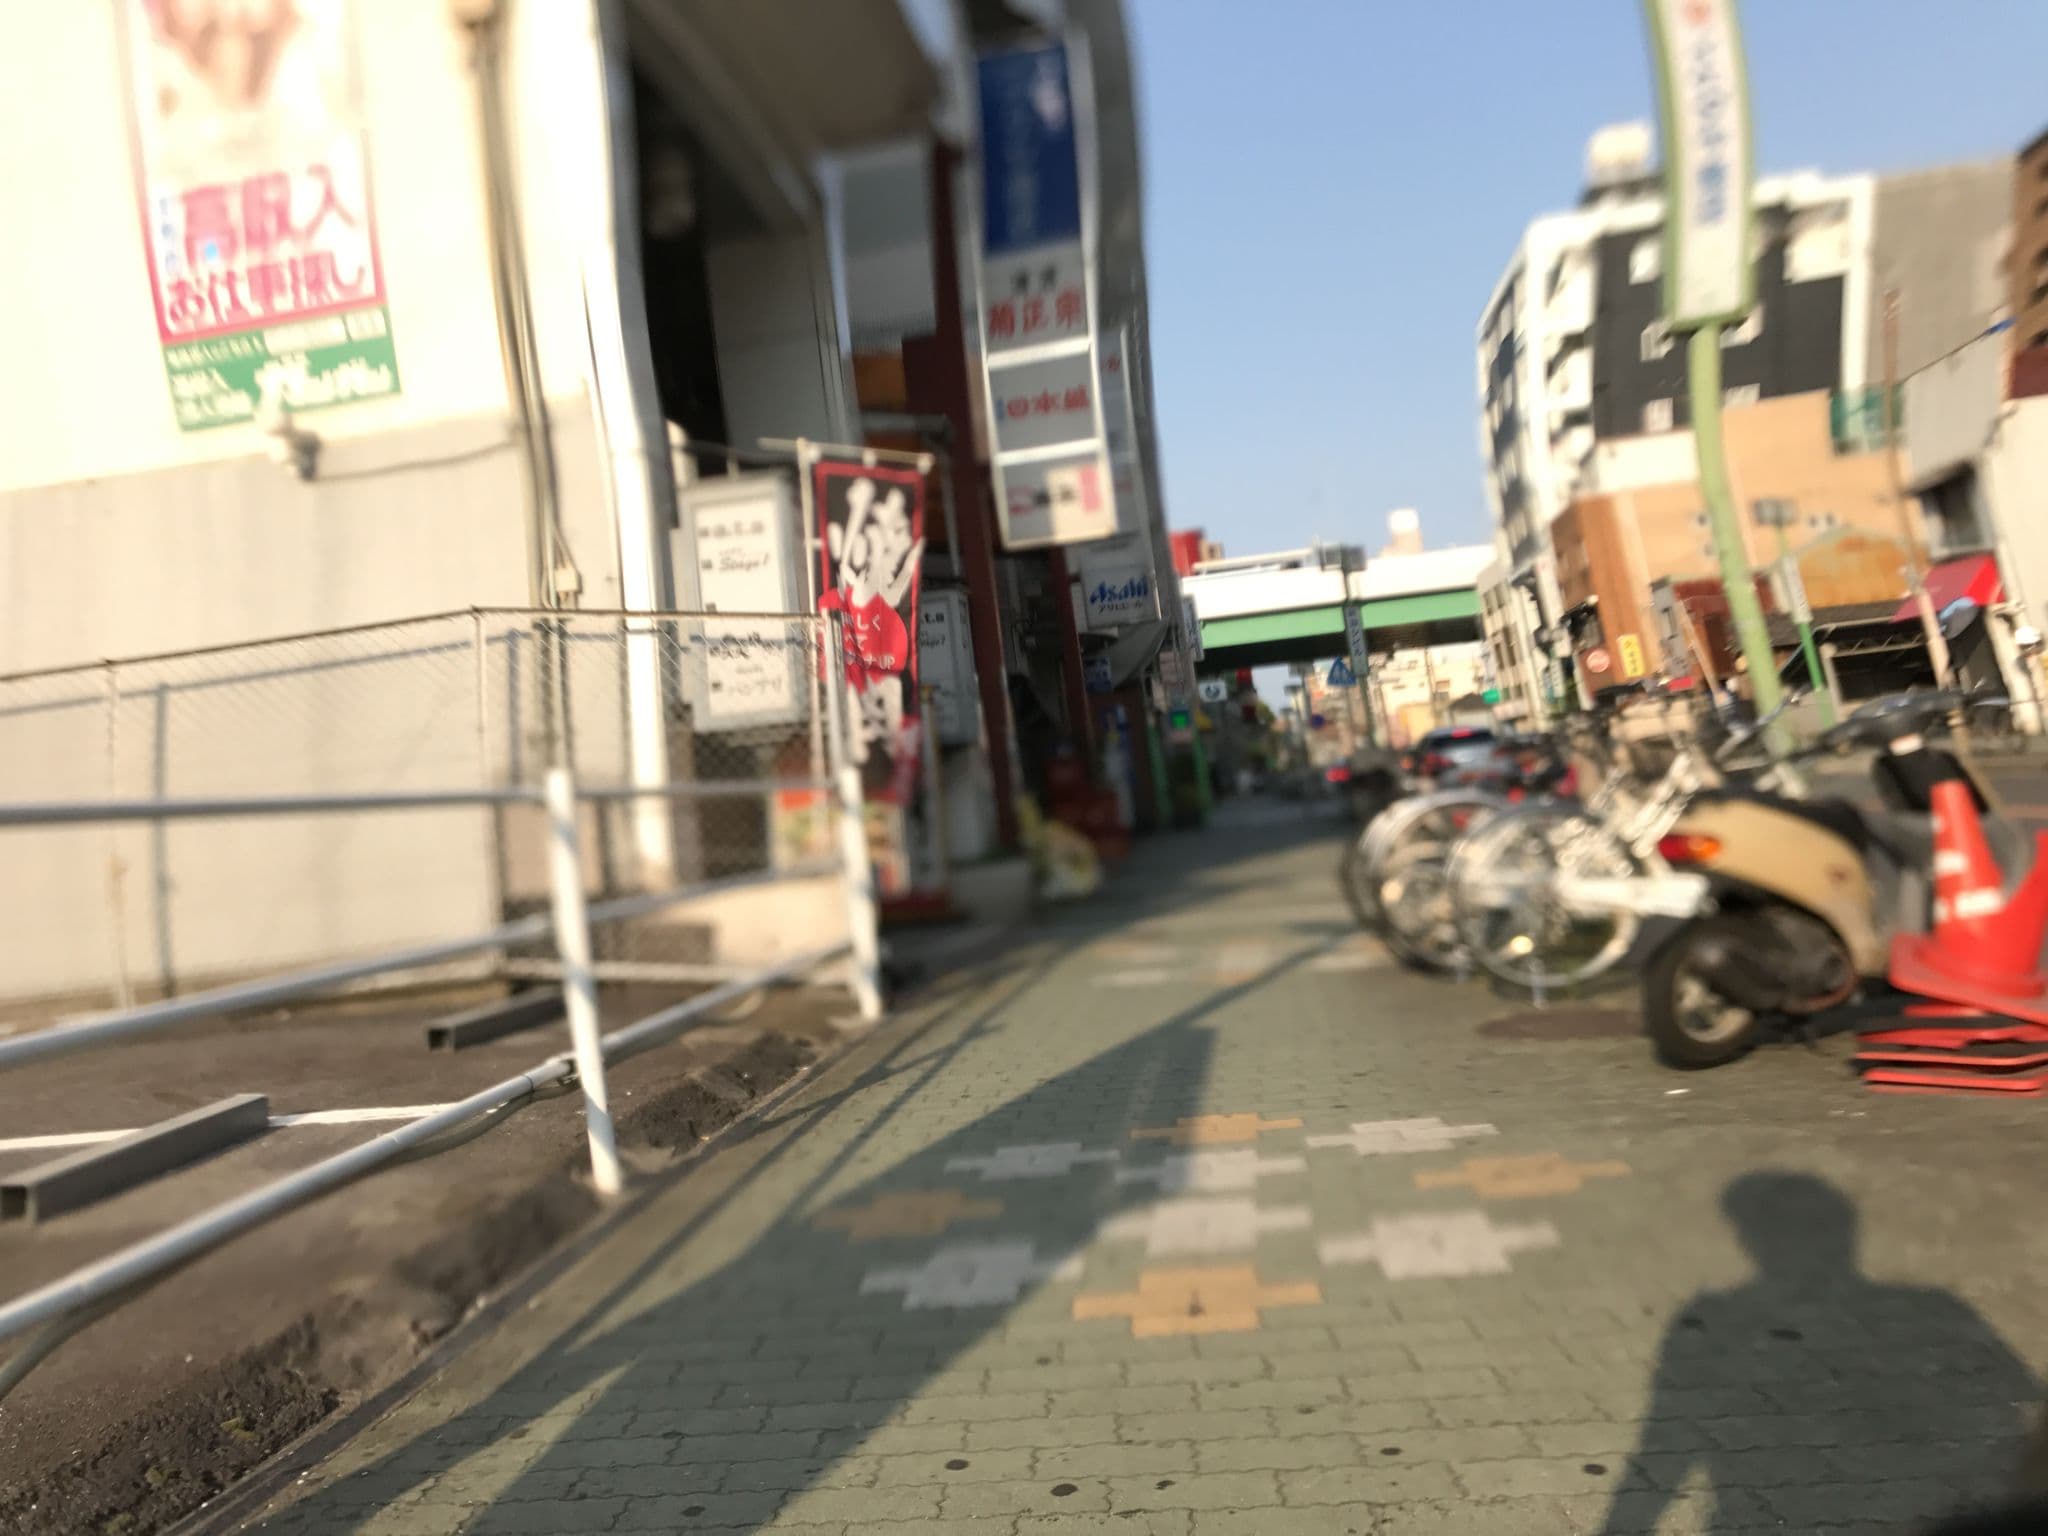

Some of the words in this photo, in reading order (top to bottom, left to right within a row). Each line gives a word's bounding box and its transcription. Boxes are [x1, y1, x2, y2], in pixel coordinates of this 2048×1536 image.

[167, 251, 366, 333] お仕事探し
[1089, 576, 1149, 605] Asahi
